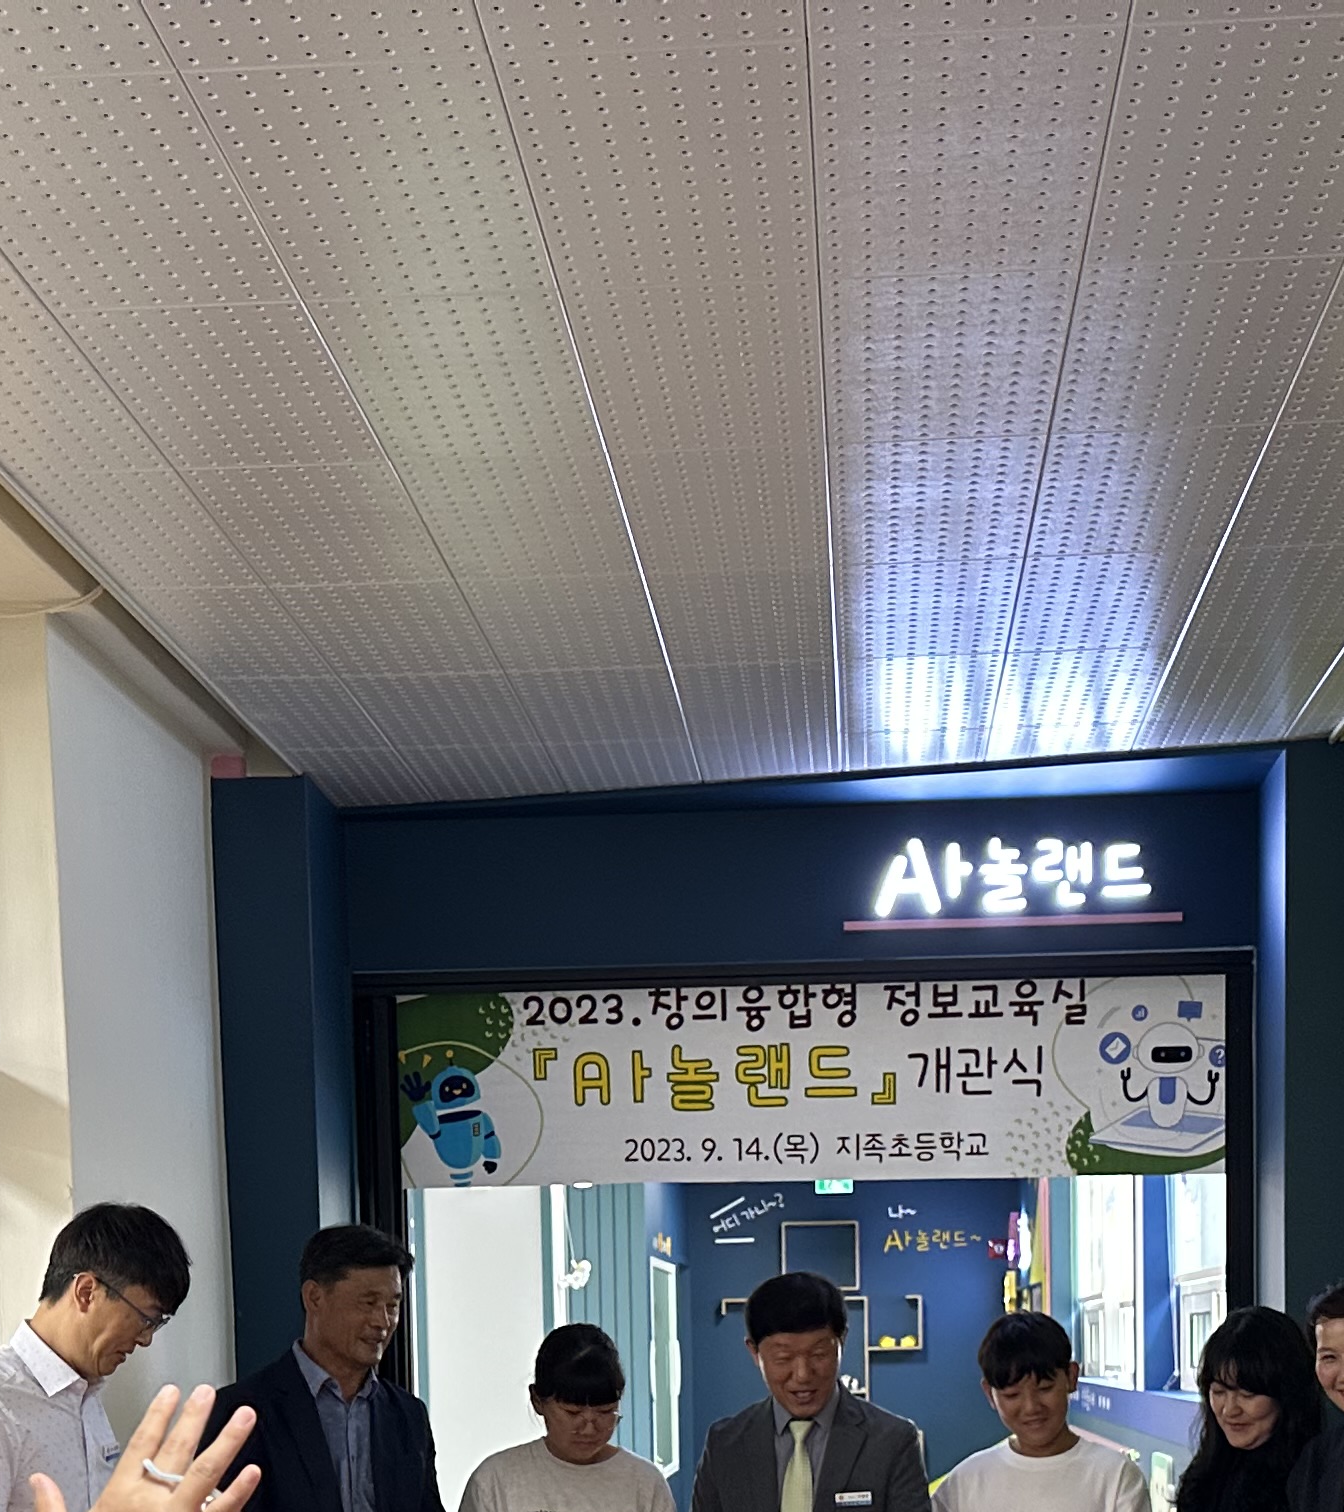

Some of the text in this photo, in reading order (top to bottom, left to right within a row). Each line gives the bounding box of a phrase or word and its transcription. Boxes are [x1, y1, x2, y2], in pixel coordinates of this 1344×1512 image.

[883, 979, 1088, 1027] 정보교육실
[907, 1045, 1044, 1097] 개관식
[624, 1131, 990, 1164] 2023. 9. 14.(목) 지족초등학교
[713, 1213, 741, 1233] 어디
